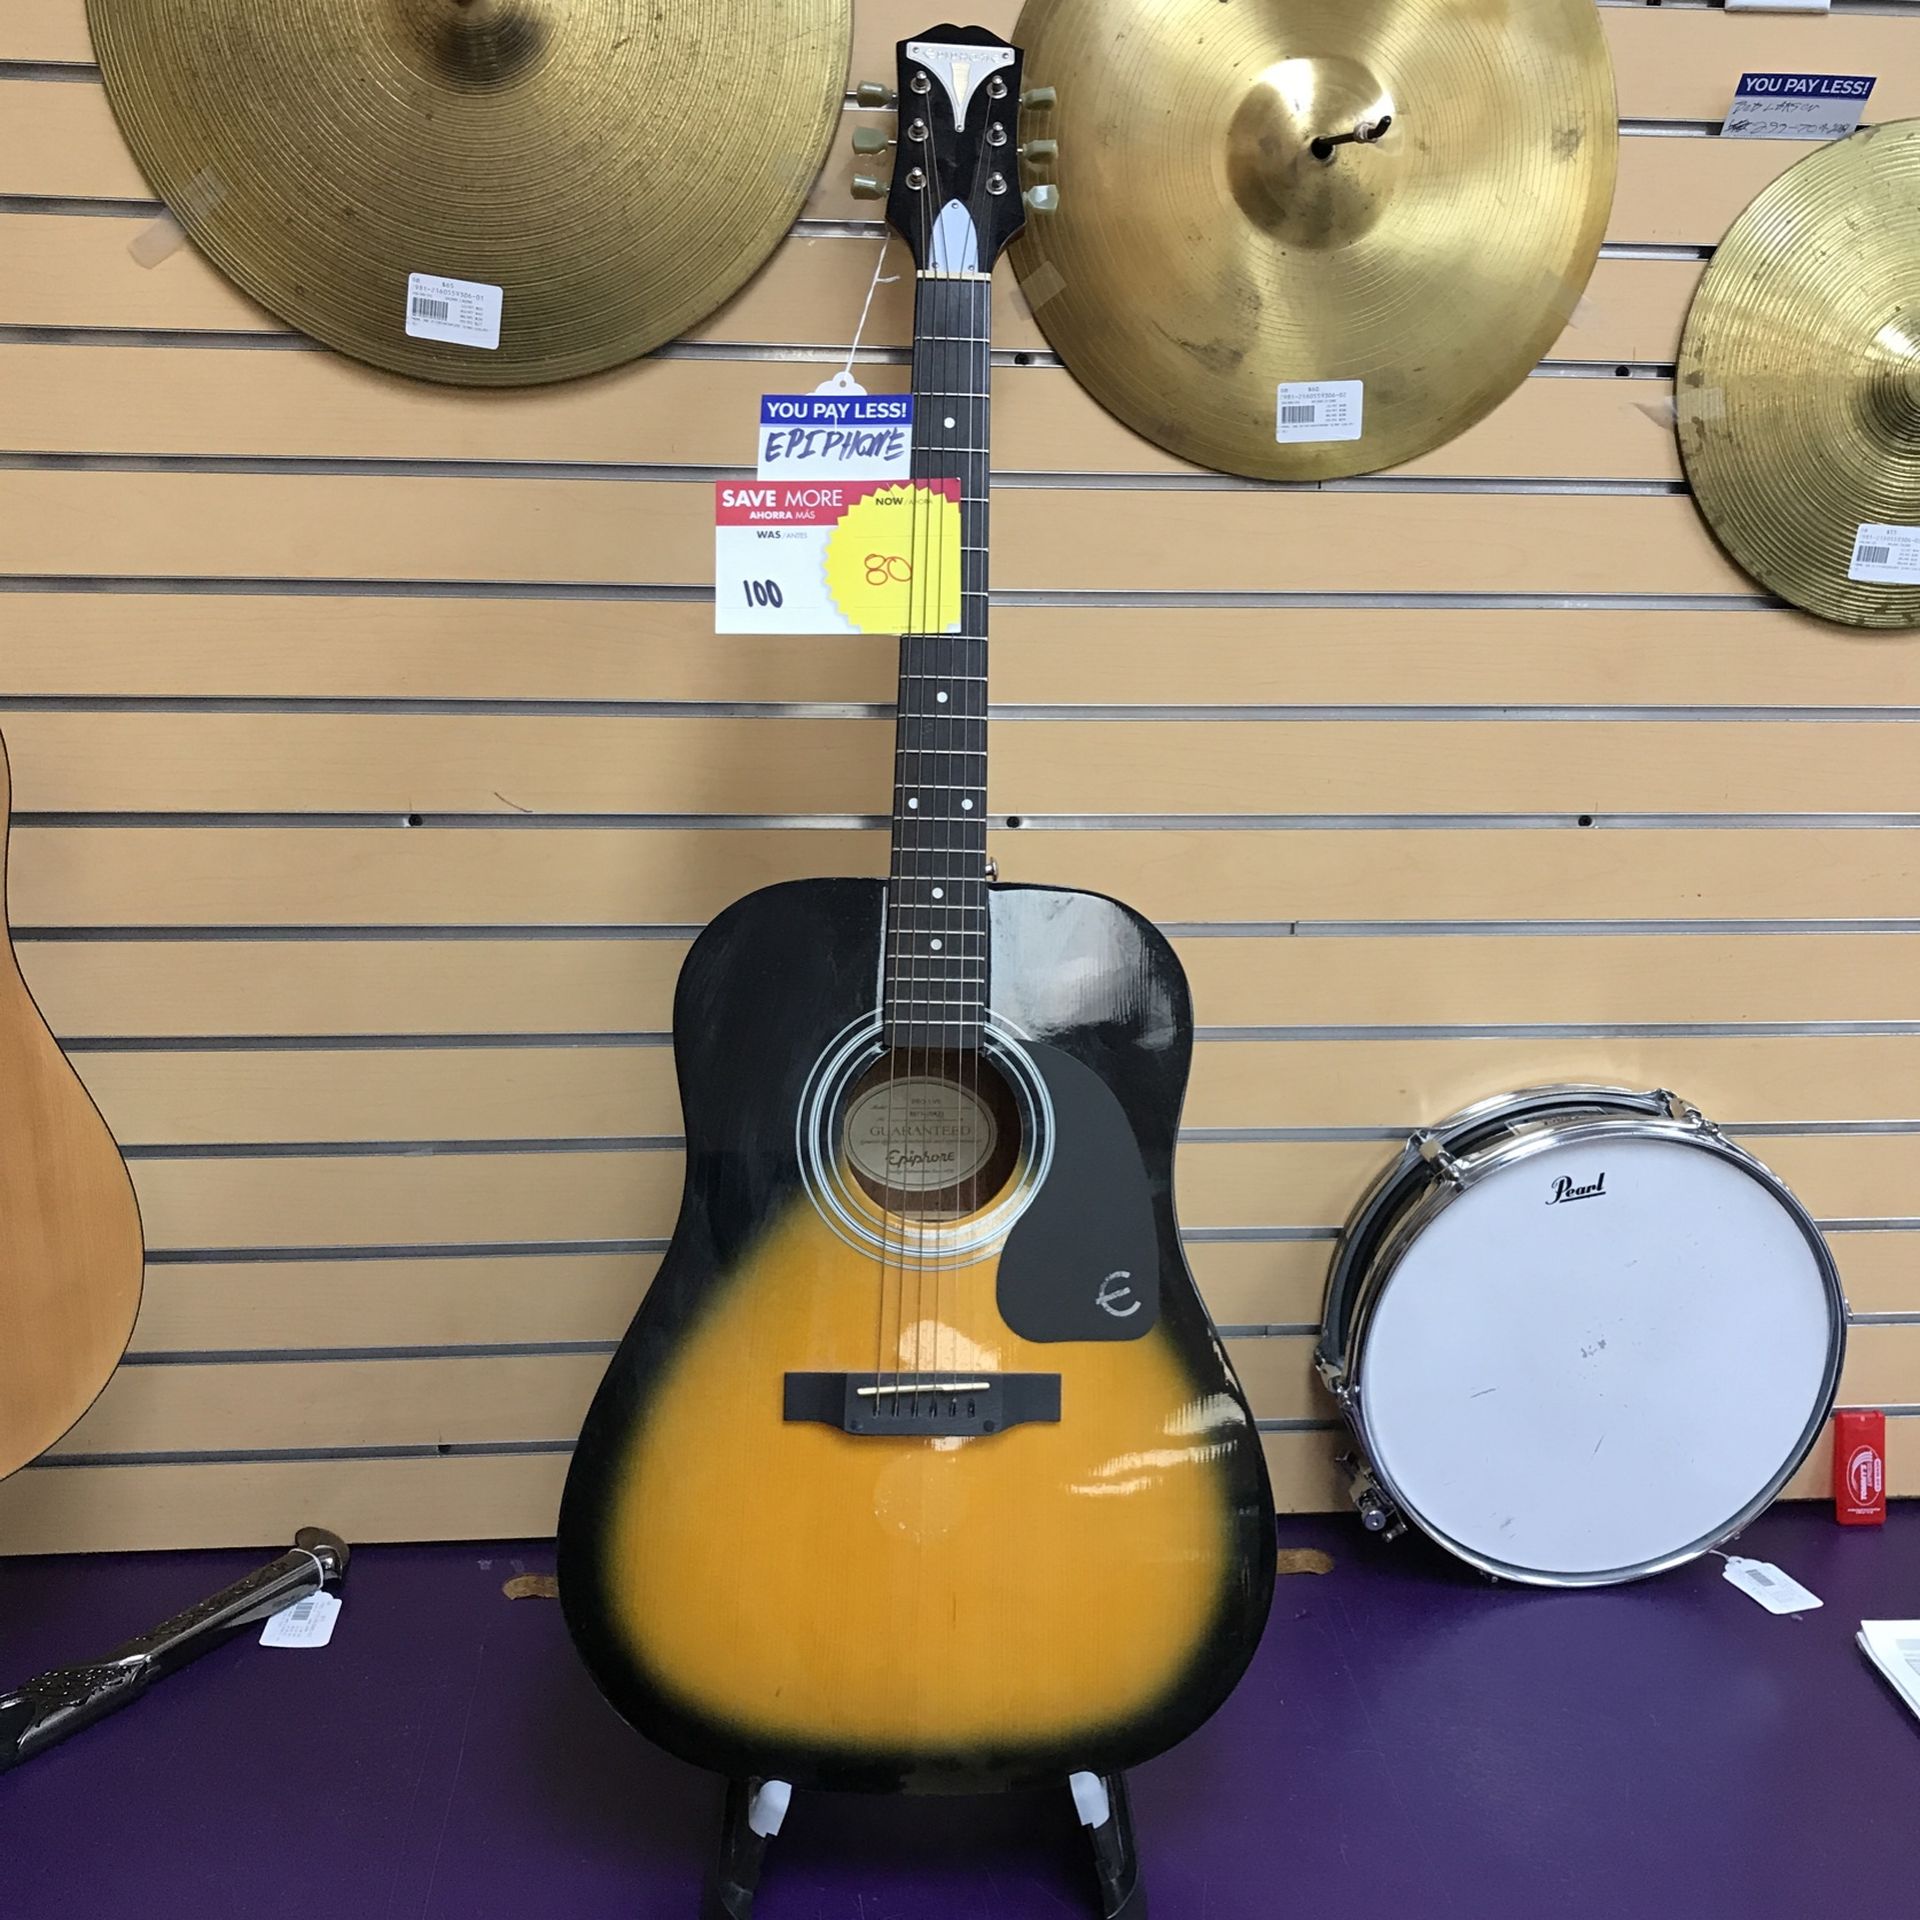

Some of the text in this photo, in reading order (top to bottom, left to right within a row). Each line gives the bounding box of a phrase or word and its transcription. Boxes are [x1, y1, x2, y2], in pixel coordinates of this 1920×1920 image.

[1745, 77, 1870, 95] YOU PAY LESS!
[767, 402, 907, 419] YOU PAY LESS!
[764, 427, 906, 463] EPIPHONE
[722, 489, 843, 508] SAVE MORE
[749, 509, 815, 520] AHORRA MÁS
[864, 553, 912, 586] 80
[743, 579, 783, 608] 100
[870, 1126, 971, 1137] GUARANTEED
[1545, 1172, 1606, 1205] Pearl
